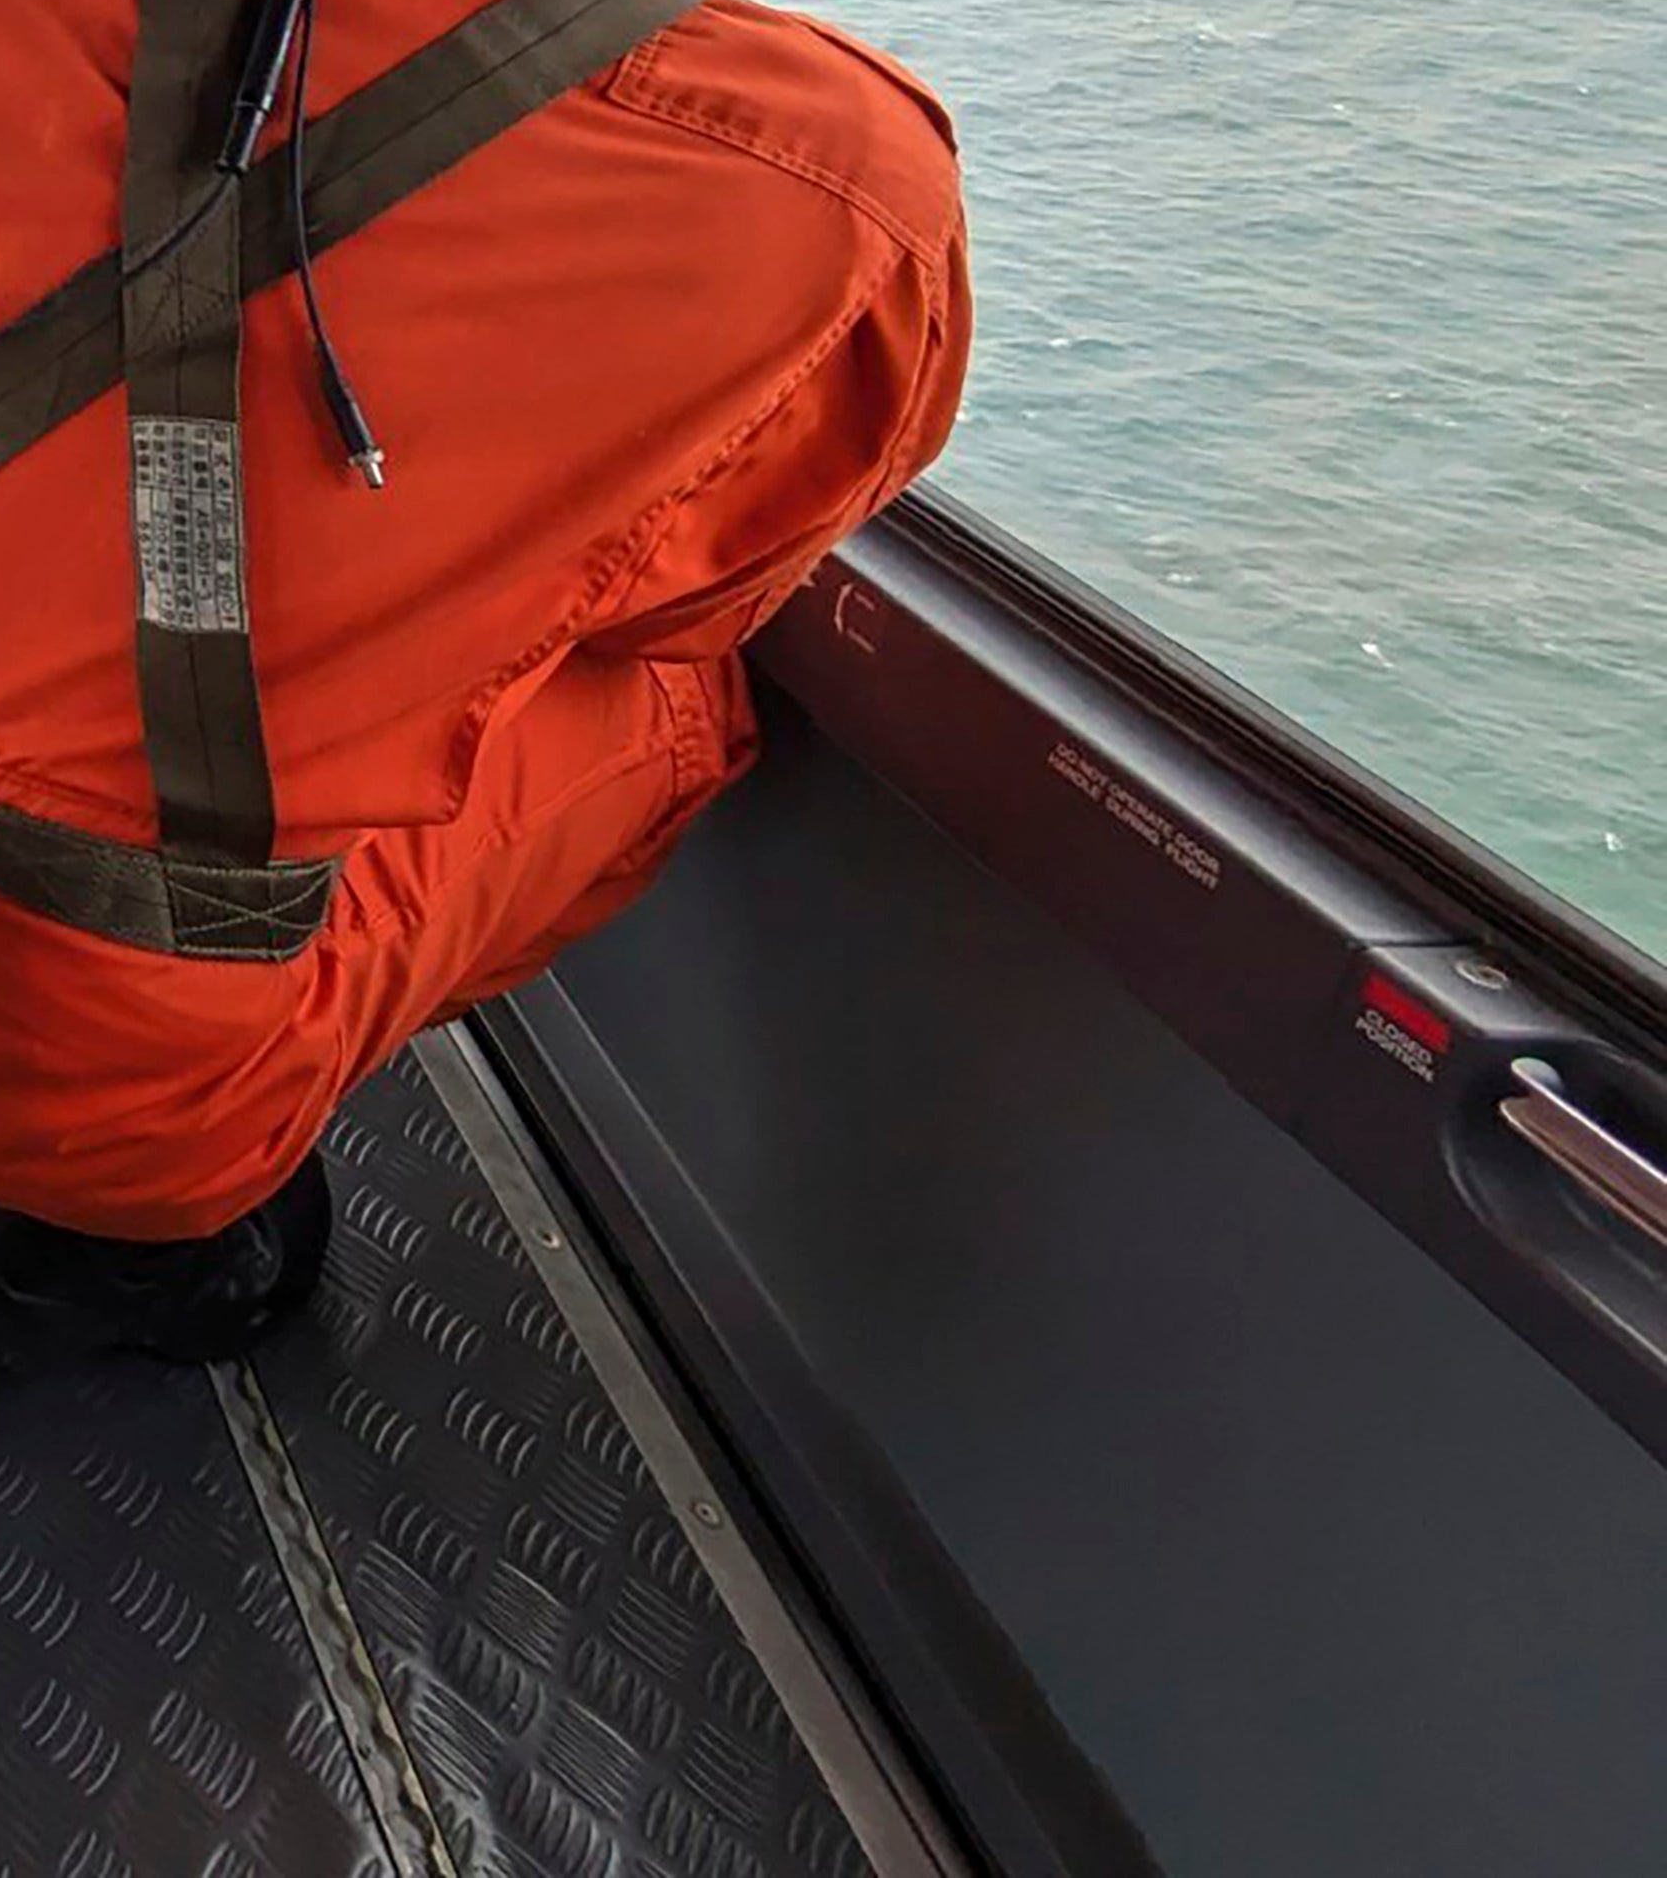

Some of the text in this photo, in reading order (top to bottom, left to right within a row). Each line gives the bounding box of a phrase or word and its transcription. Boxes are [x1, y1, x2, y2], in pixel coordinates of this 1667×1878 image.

[1048, 751, 1219, 890] HANDLE DURING FLIGHT
[1055, 742, 1220, 874] DO NOT OPERATE DOOR
[1354, 1016, 1434, 1084] POSITION
[1366, 1009, 1433, 1065] CLOSED
